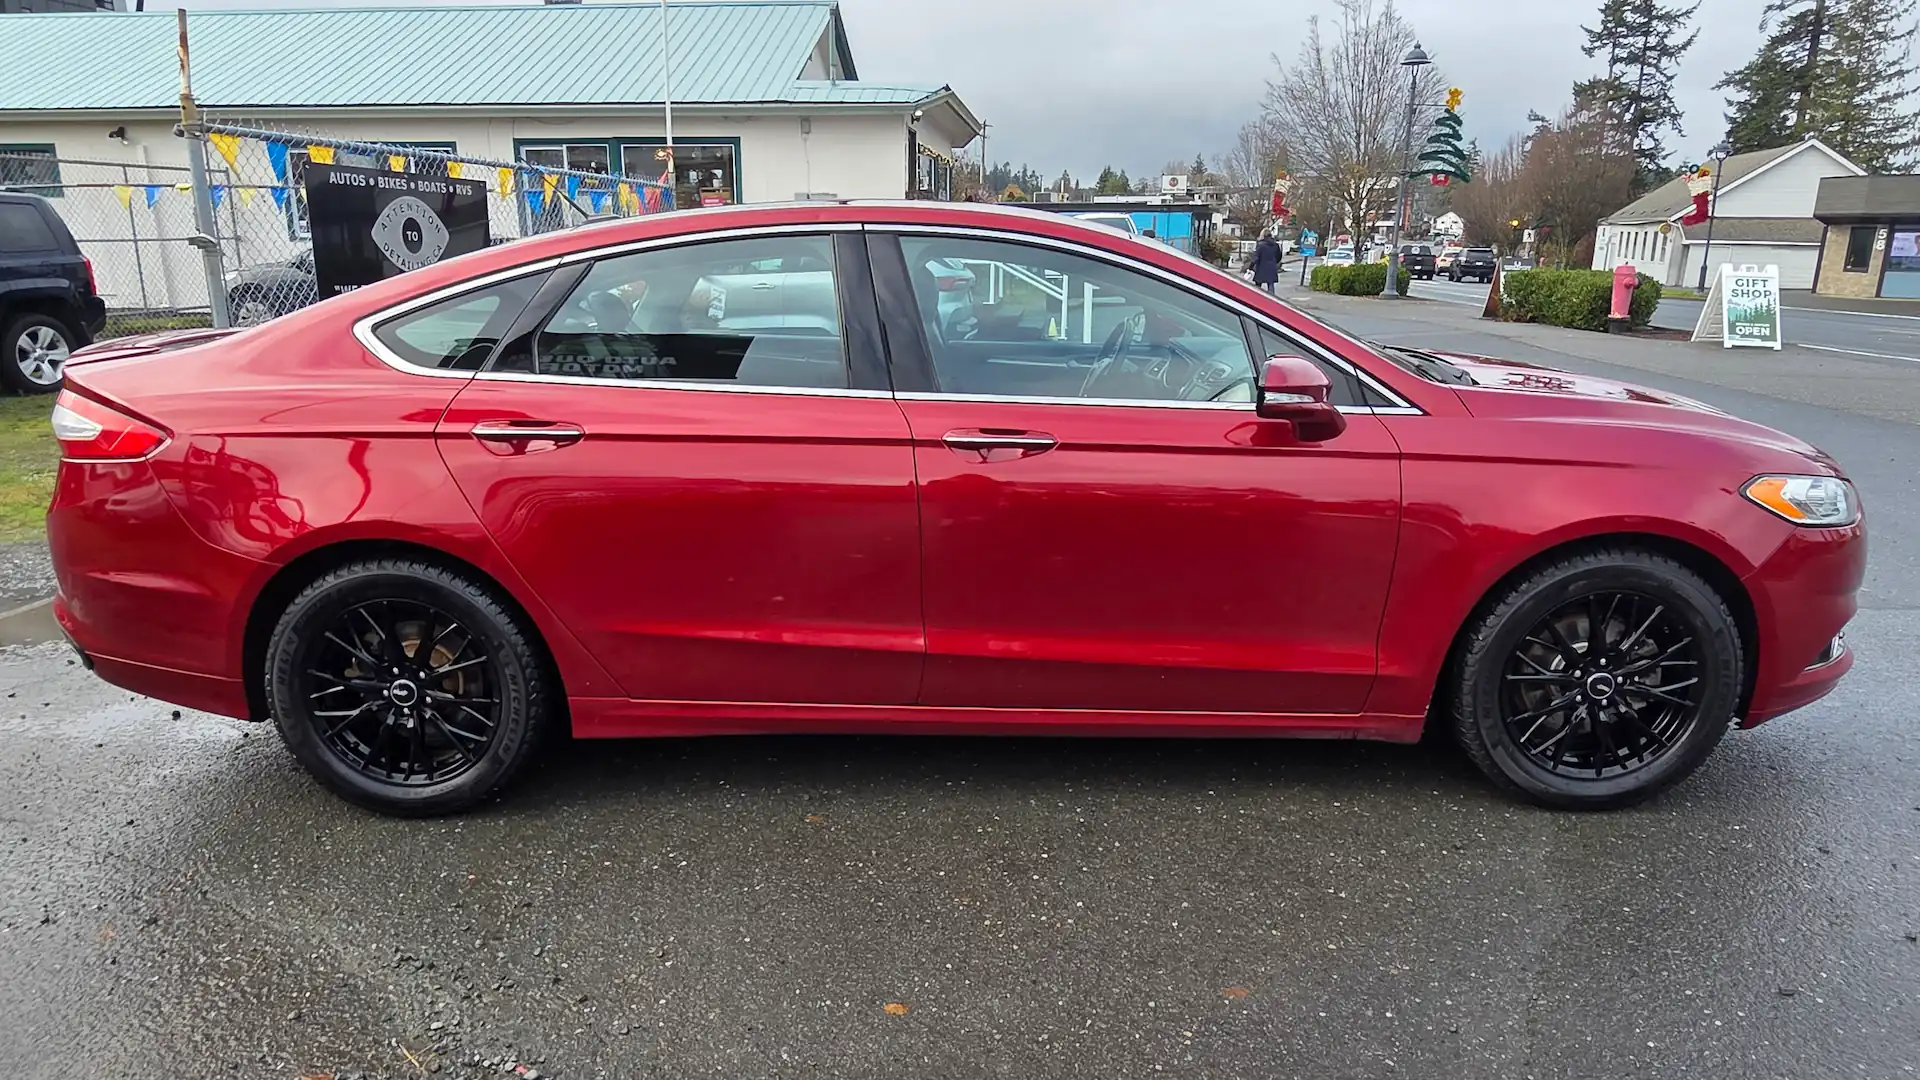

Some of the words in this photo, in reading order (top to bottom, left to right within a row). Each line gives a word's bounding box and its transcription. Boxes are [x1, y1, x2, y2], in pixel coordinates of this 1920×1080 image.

[329, 171, 366, 187] AUTOS
[377, 176, 407, 190] BIKES
[418, 180, 446, 194] BOATS
[456, 184, 472, 196] RVS
[381, 202, 441, 233] ATTENTION
[406, 231, 419, 241] TO
[1735, 278, 1768, 288] GIFT
[1731, 288, 1772, 298] SHOP
[1736, 326, 1770, 336] OPEN
